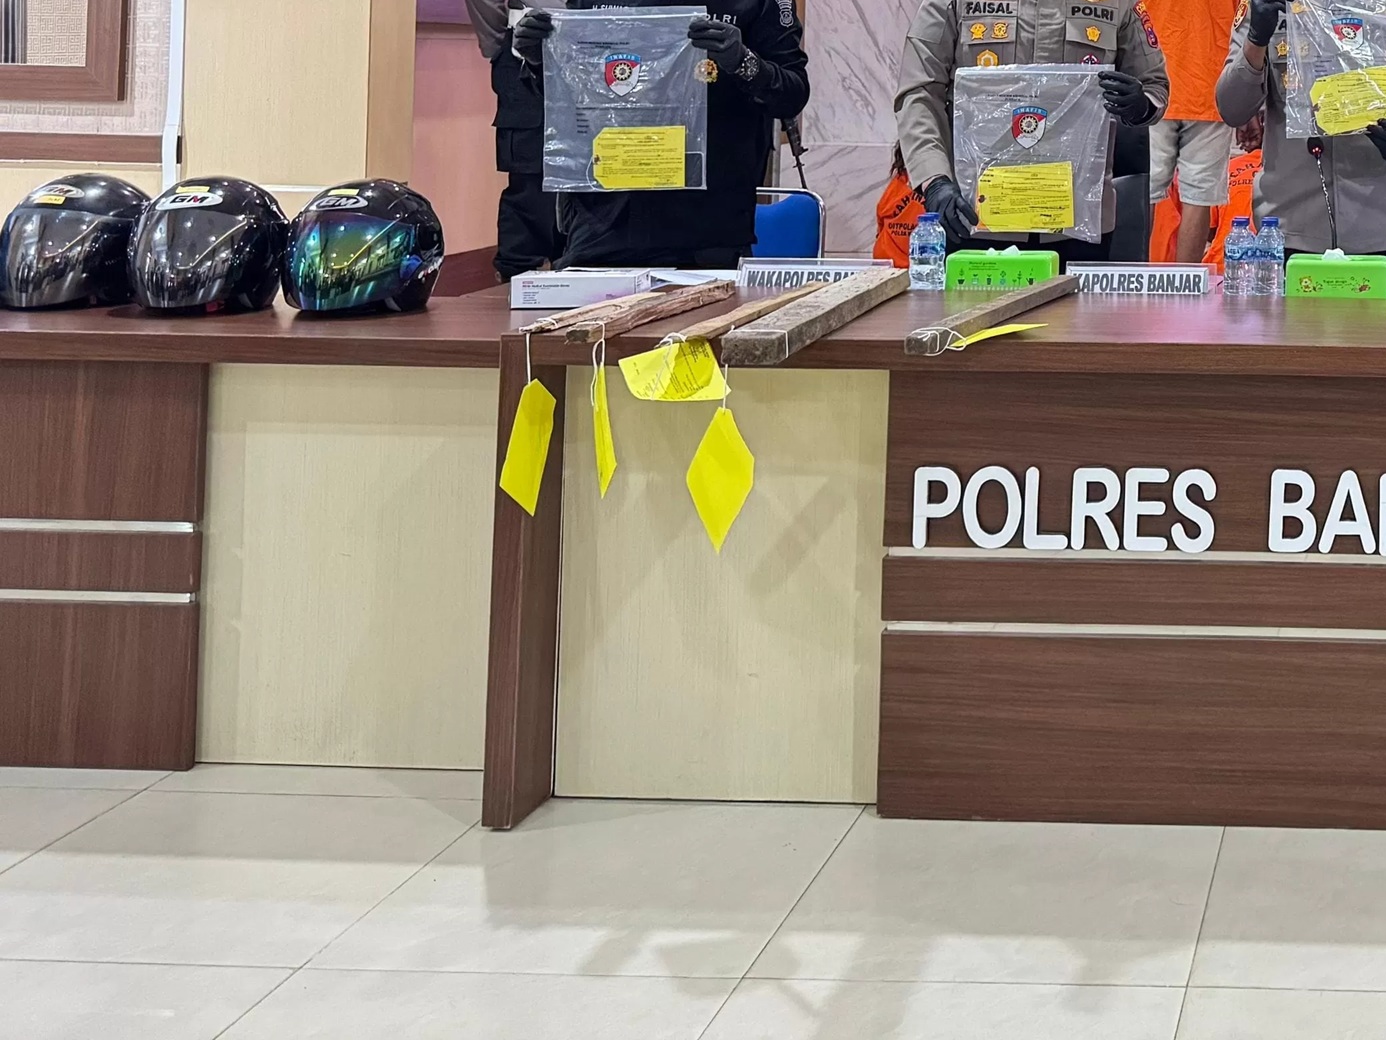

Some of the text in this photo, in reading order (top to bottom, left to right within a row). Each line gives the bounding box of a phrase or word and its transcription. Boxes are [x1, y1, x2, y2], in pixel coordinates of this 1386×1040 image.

[705, 13, 737, 25] OLRI
[964, 1, 1114, 21] FAISAL POLRI
[170, 195, 210, 204] GM
[316, 196, 360, 209] GM
[1073, 273, 1202, 293] KAPOLRES BANJAR
[913, 465, 1217, 554] POLRES
